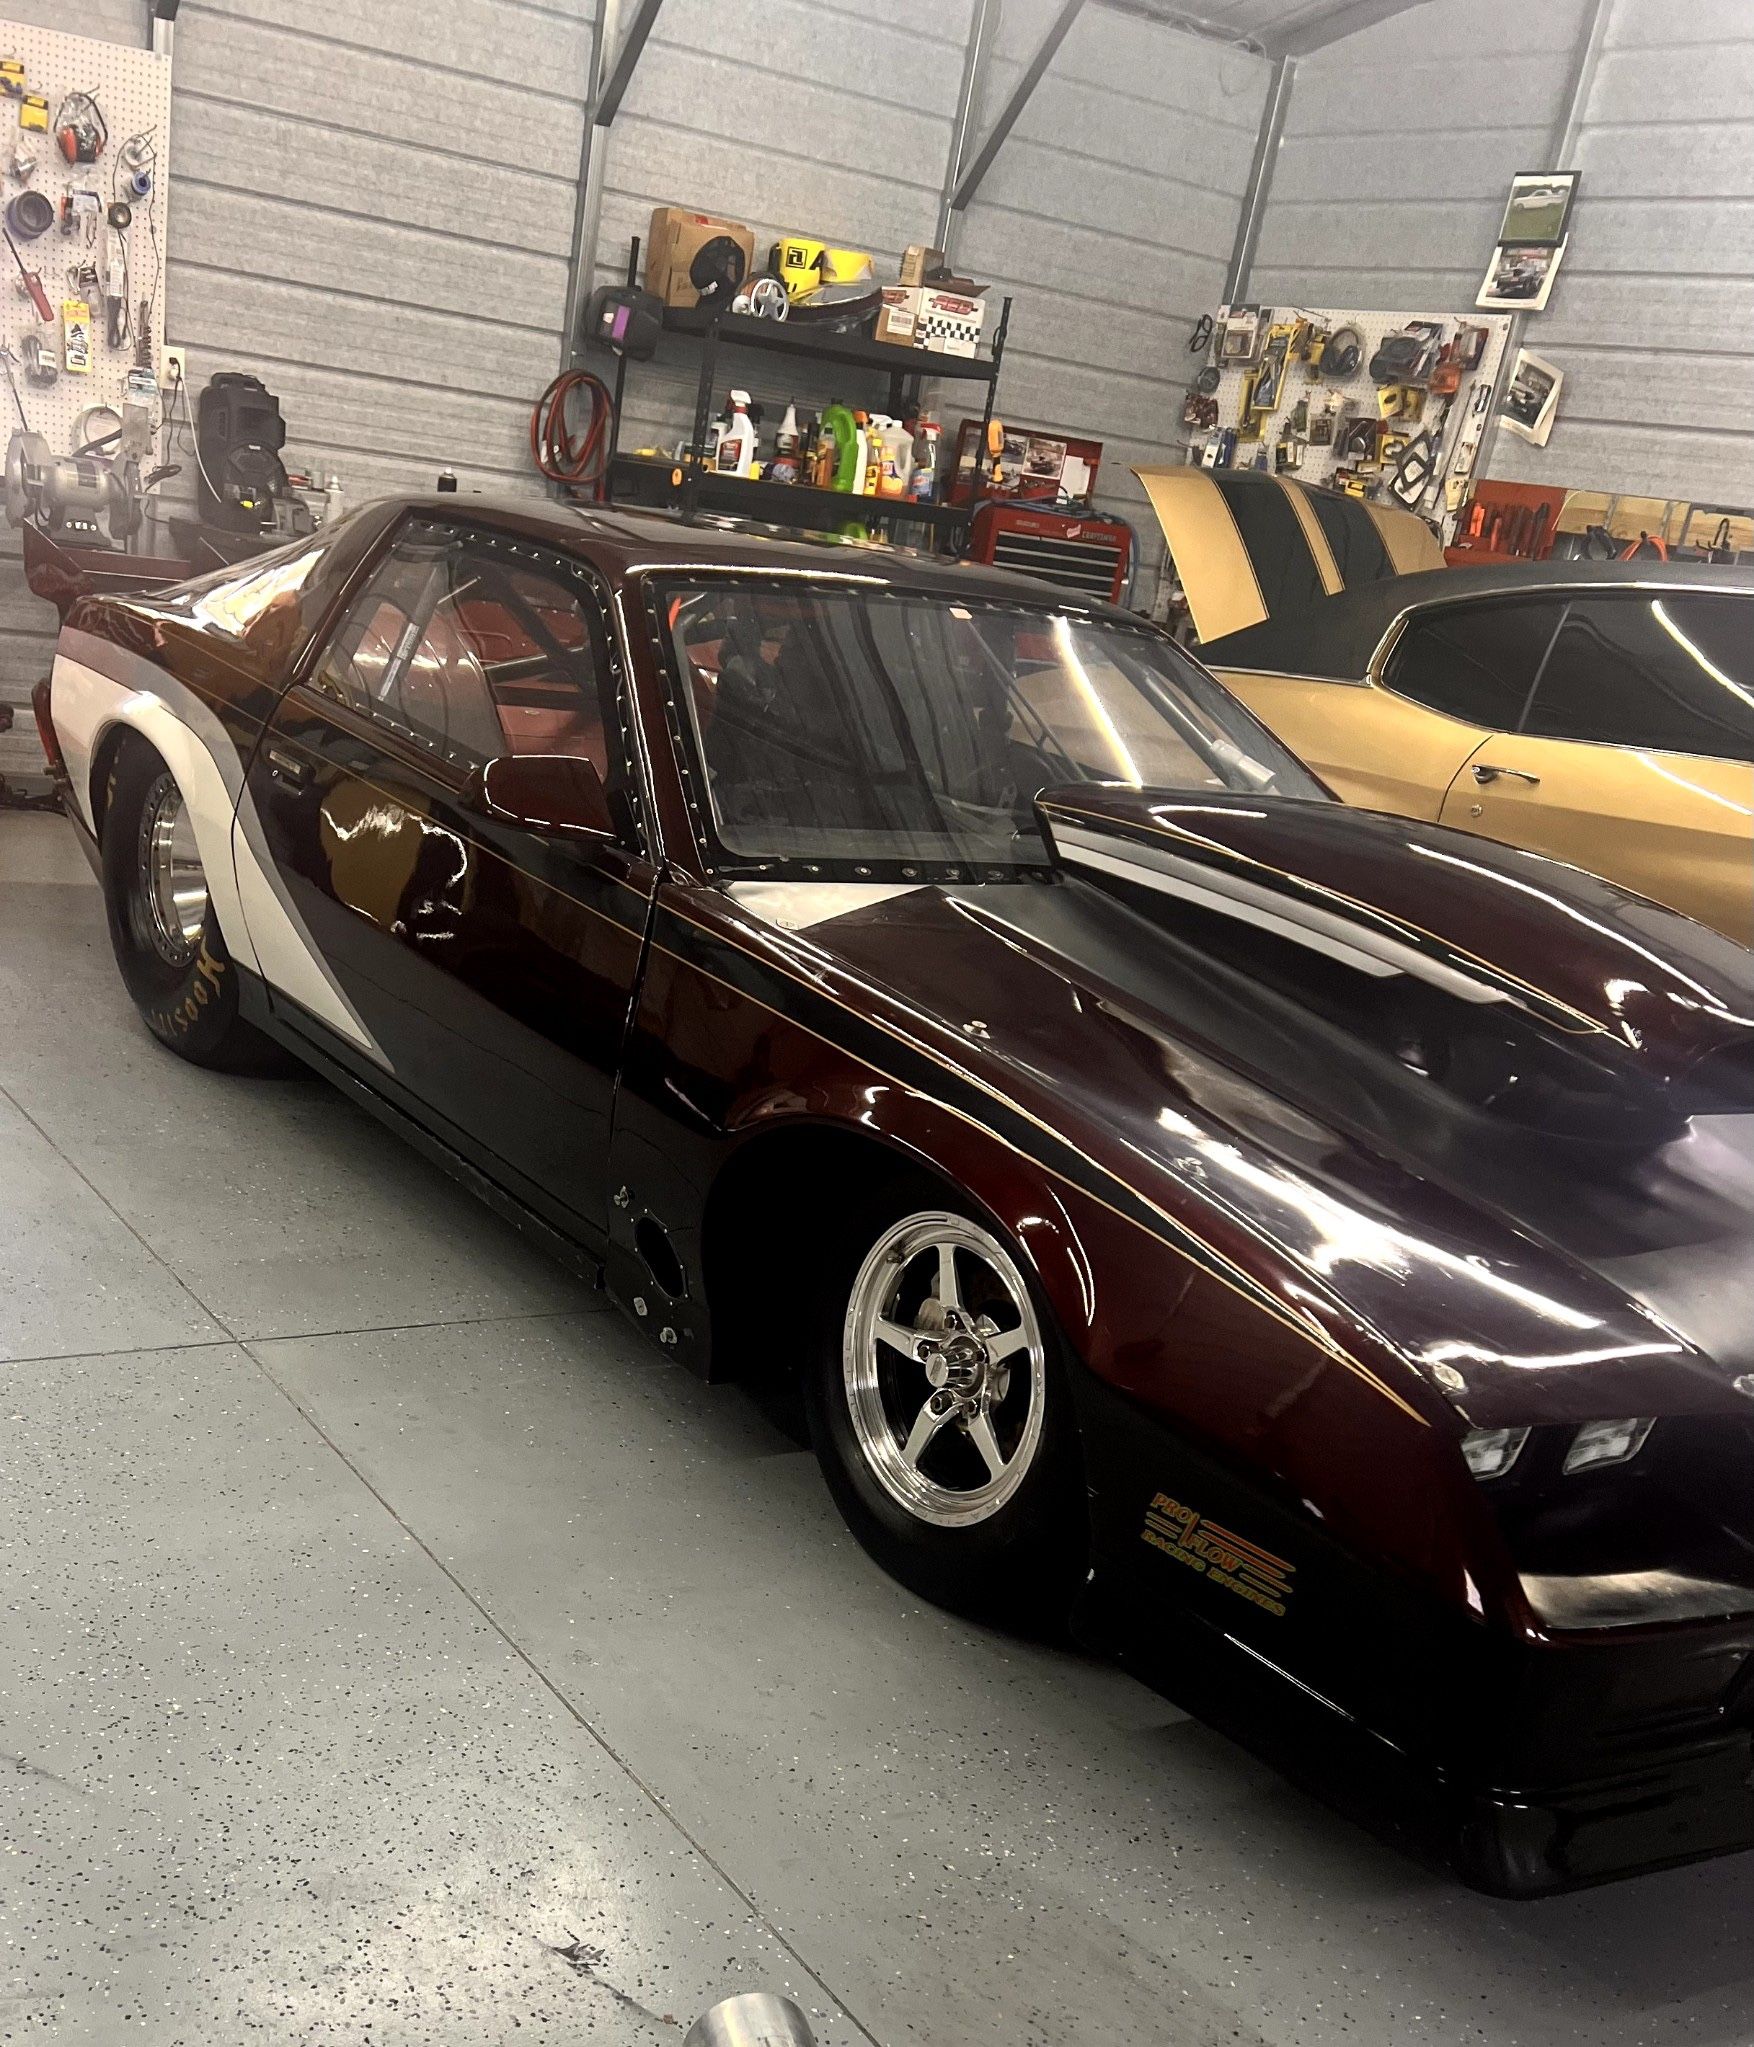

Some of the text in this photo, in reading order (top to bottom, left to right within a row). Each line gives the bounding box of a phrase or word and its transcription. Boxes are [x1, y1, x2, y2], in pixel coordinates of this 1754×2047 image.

[1149, 1491, 1194, 1524] PRO
[1139, 1529, 1286, 1617] RACING ENGINES
